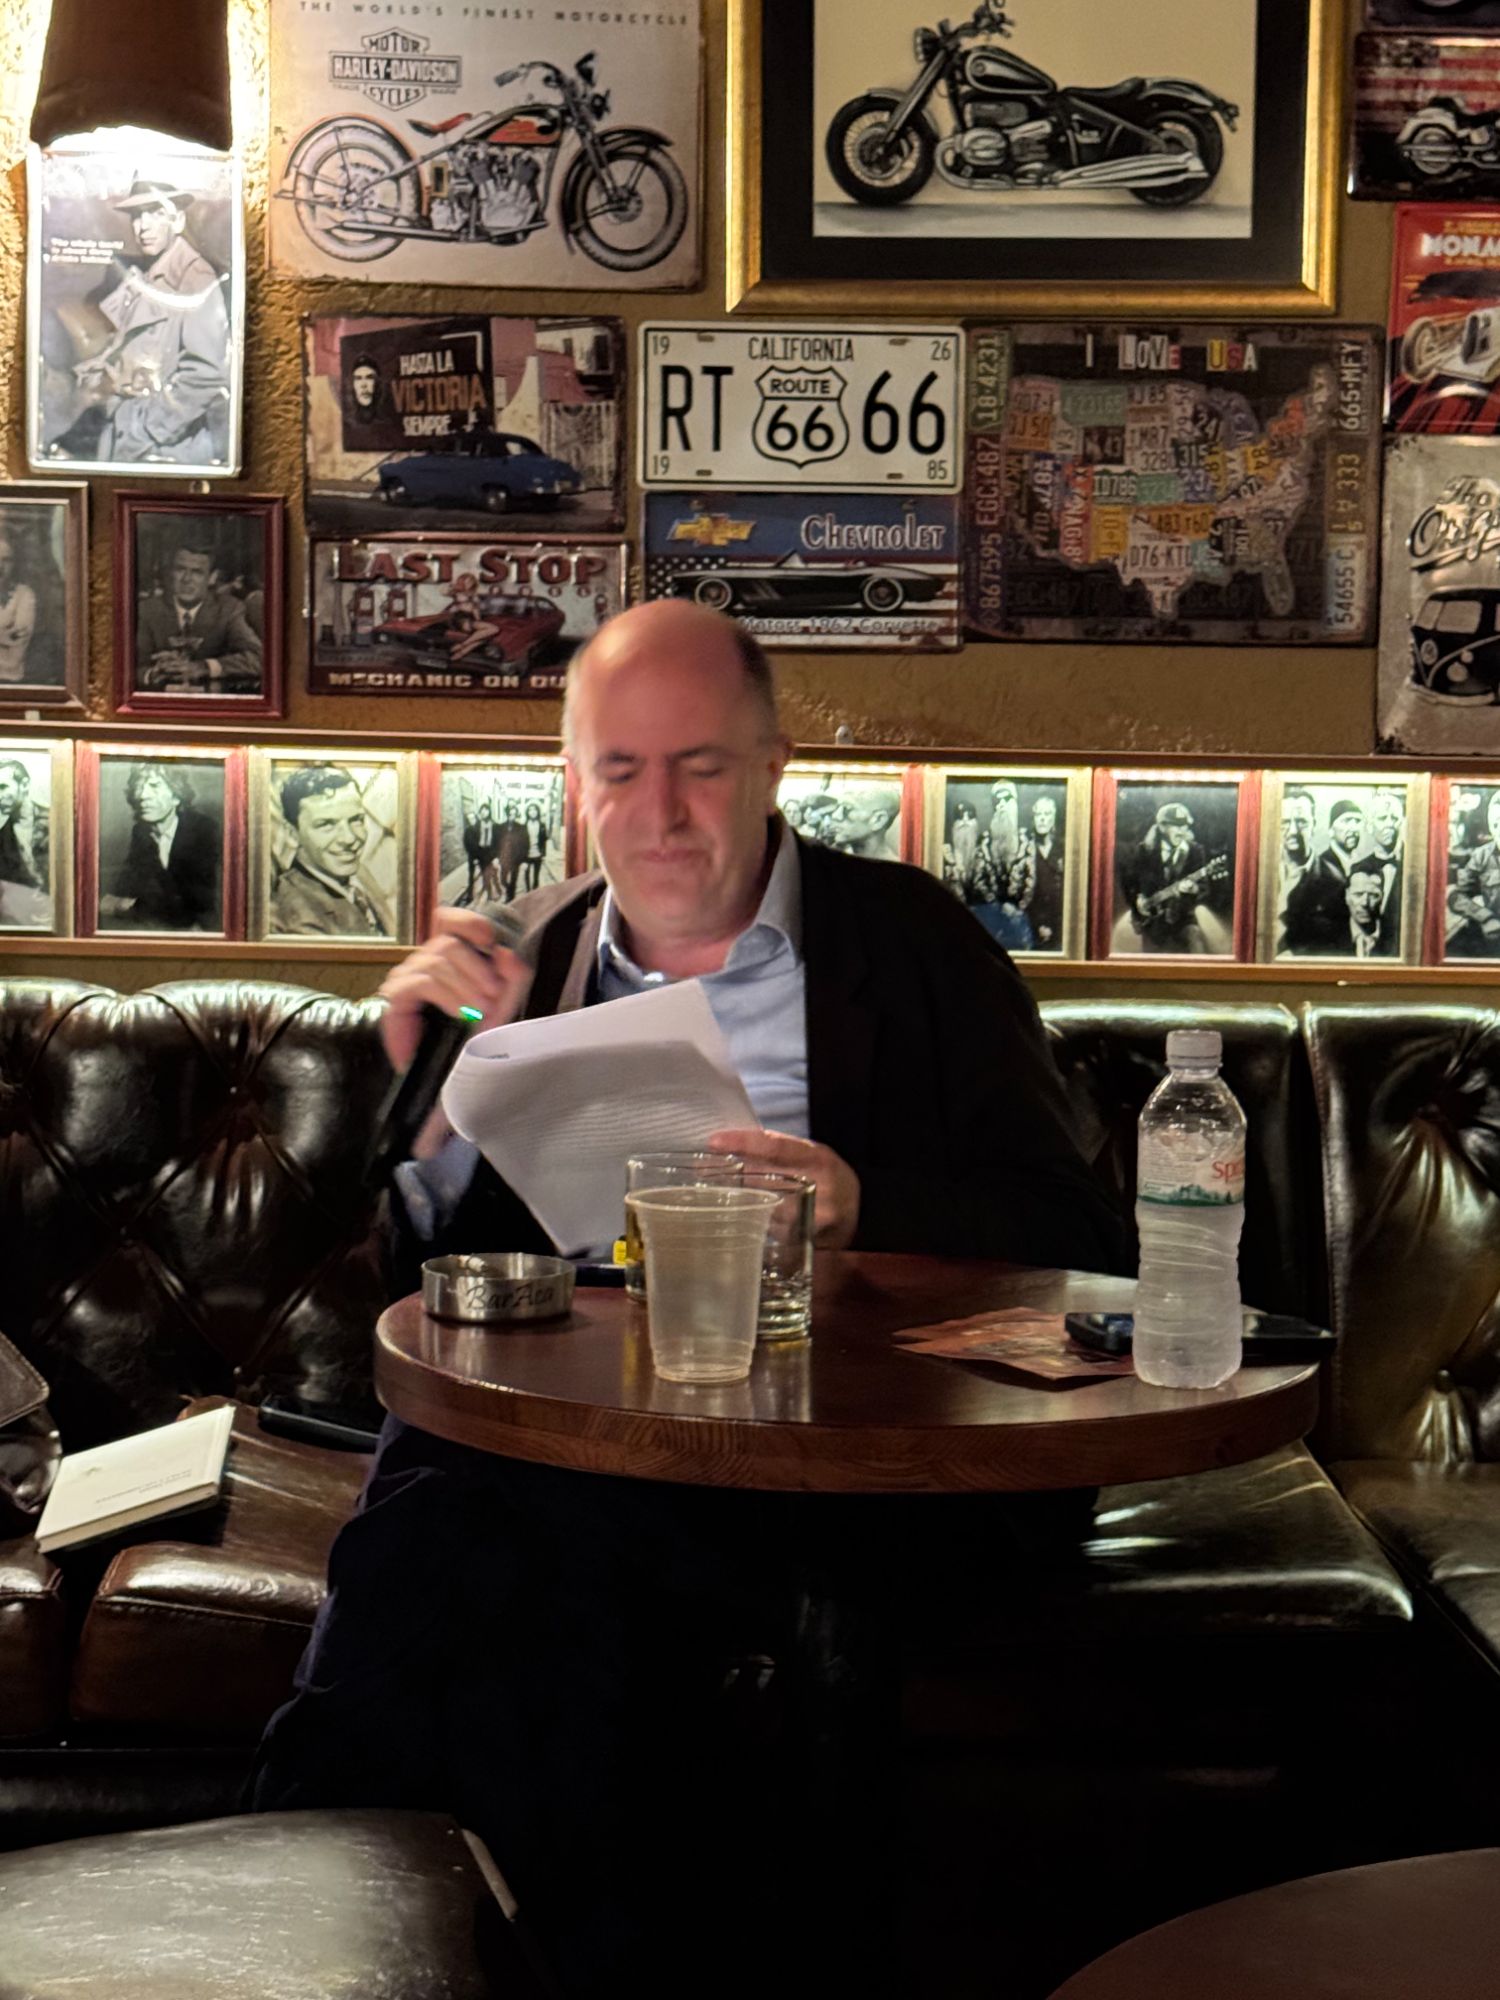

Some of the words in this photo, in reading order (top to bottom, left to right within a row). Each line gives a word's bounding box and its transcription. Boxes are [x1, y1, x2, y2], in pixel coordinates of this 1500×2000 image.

[300, 2, 331, 12] THE
[463, 7, 534, 20] FINEST
[555, 11, 687, 26] MOTORCYCLE
[369, 32, 421, 52] MOTOR
[334, 57, 458, 82] HARLEY-DAVIDSON
[369, 87, 421, 106] CYCLES
[1421, 233, 1500, 257] MONA
[652, 335, 671, 356] 19
[748, 336, 855, 362] CALIFORNIA
[930, 340, 951, 361] 26
[1086, 333, 1093, 368] I
[1208, 338, 1257, 371] USA
[400, 351, 435, 376] HASTA
[436, 350, 454, 373] LA
[391, 374, 486, 413] VICTORIA
[770, 378, 831, 395] ROUTE
[660, 364, 734, 452] RT
[862, 370, 945, 455] 66
[766, 403, 835, 452] 66
[652, 455, 671, 476] 19
[927, 459, 948, 480] 85
[336, 544, 460, 582] LAST
[479, 548, 607, 585] STOP
[809, 616, 852, 633] 1962
[858, 616, 939, 633] Corvette
[328, 672, 472, 688] MECHANIC
[483, 674, 519, 688] ON
[530, 675, 567, 689] DU
